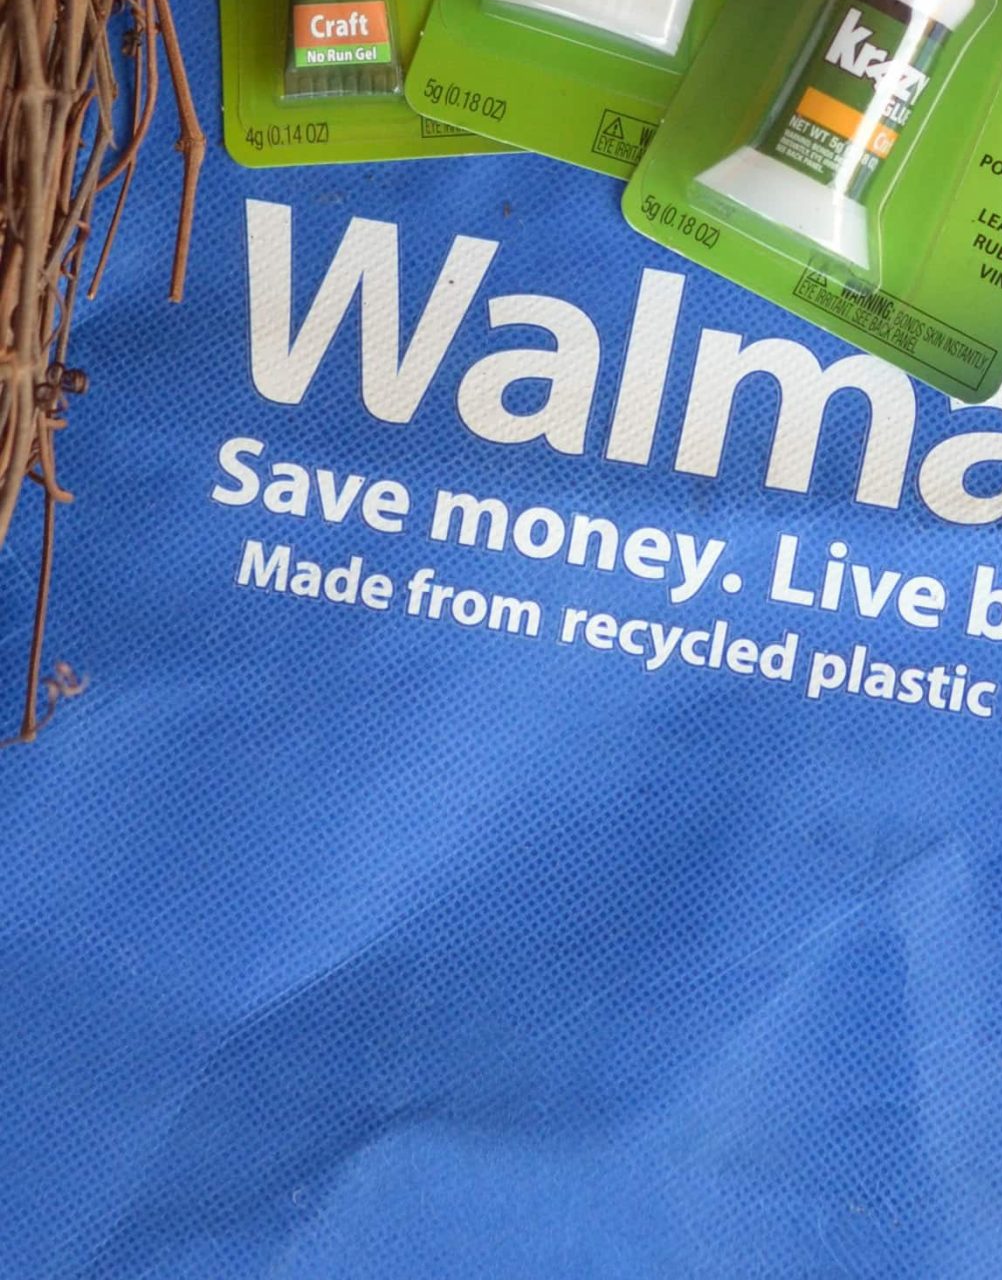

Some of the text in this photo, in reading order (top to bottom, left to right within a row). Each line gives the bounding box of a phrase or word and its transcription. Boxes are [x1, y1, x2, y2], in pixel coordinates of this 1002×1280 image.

[310, 12, 369, 38] Craft
[307, 46, 377, 63] No Run Gel
[424, 78, 443, 104] 5g
[444, 82, 481, 113] (0.18
[246, 126, 263, 150] 4g
[267, 124, 302, 147] (0.14
[641, 194, 661, 221] 5g
[660, 203, 696, 235] (0.18
[799, 279, 819, 300] EYE
[211, 435, 411, 534] Save
[430, 487, 743, 604] money.
[769, 533, 946, 628] Live
[236, 540, 393, 610] Made
[406, 568, 541, 636] from
[561, 607, 799, 682] recycled
[807, 645, 995, 718] plastic
